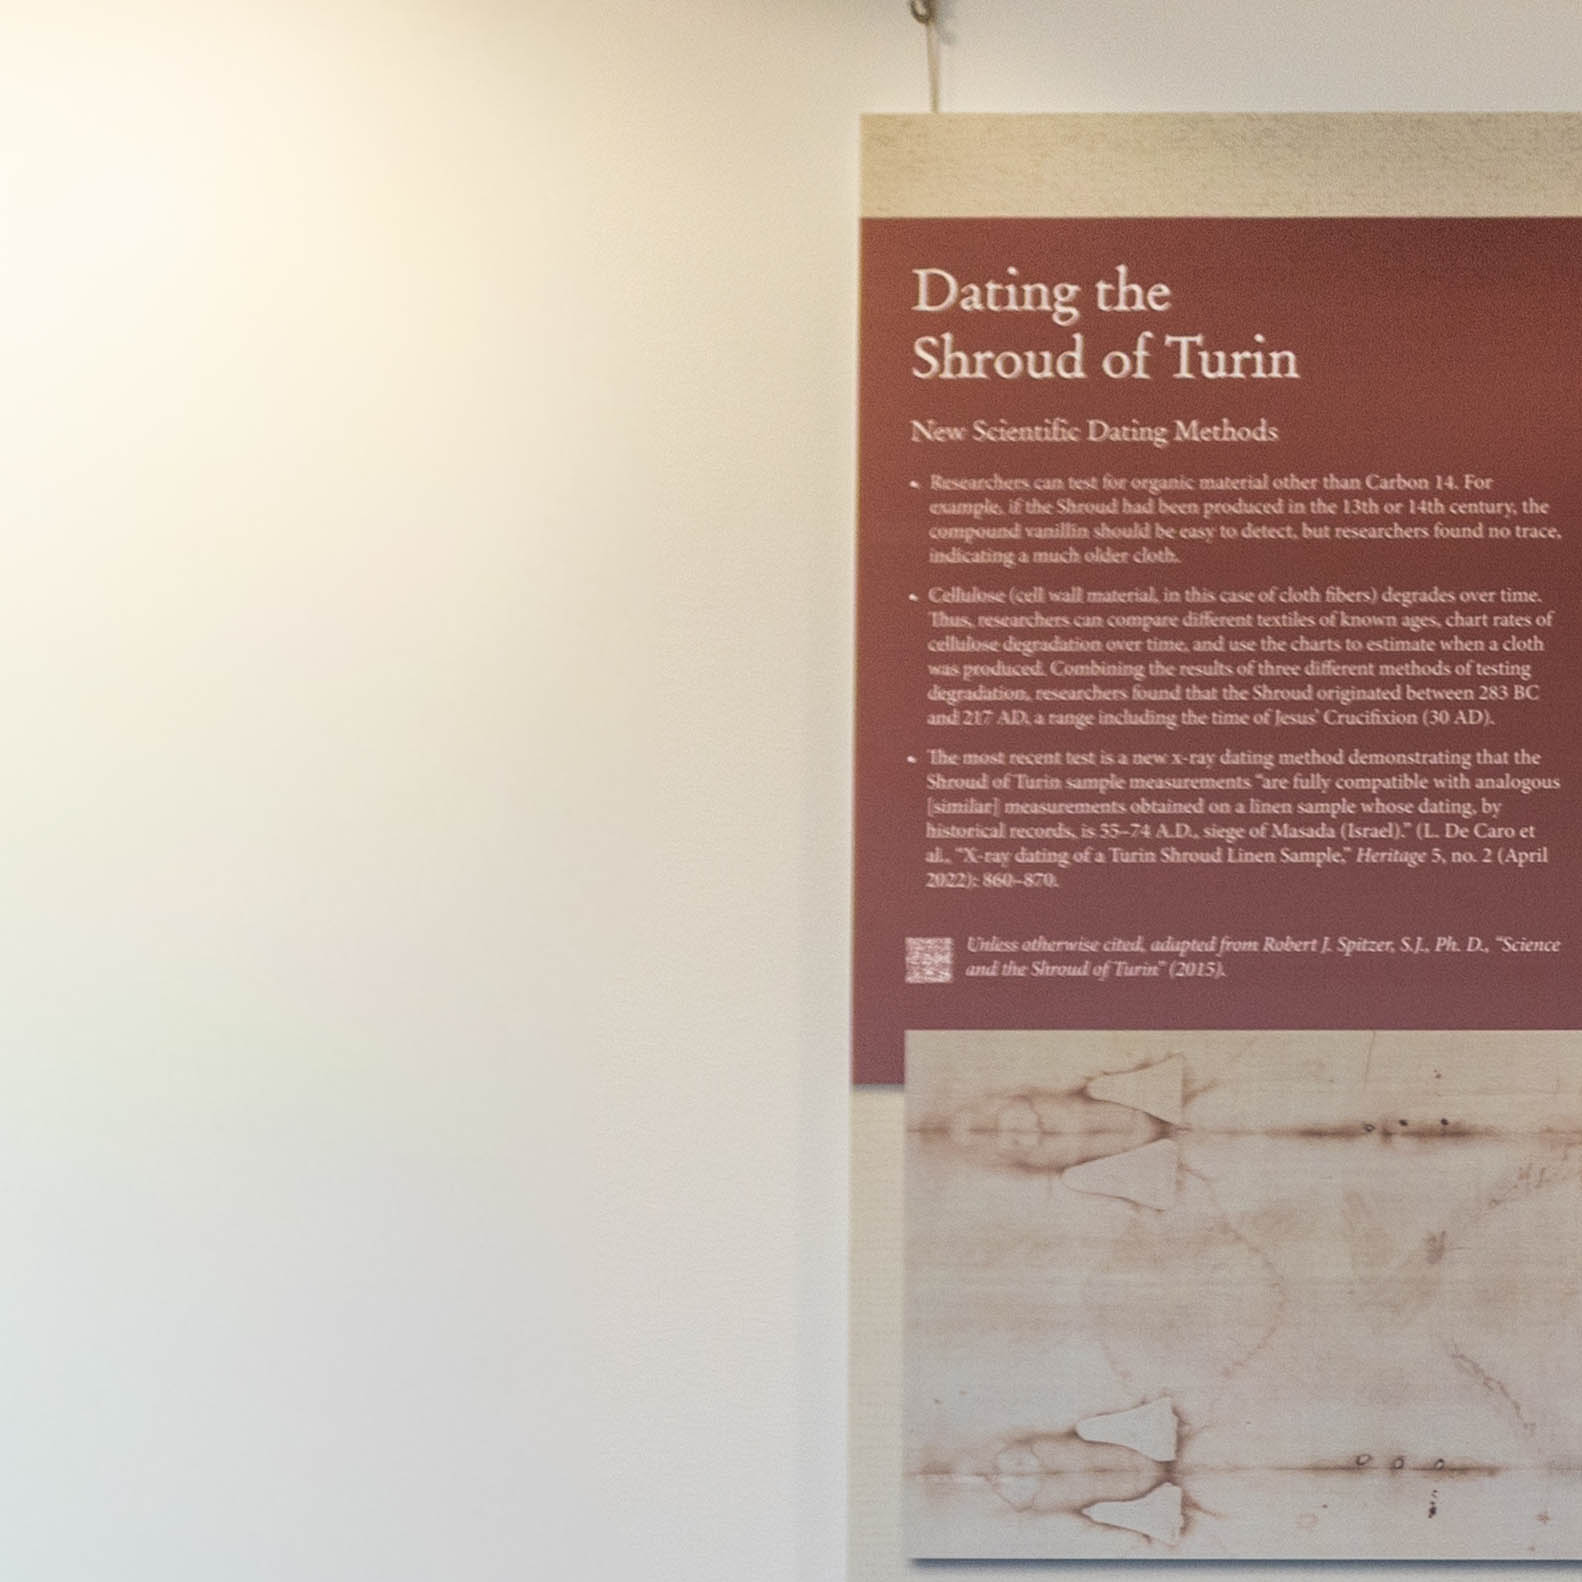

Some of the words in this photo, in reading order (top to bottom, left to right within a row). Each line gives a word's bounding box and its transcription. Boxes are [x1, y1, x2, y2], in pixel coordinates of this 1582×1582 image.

[912, 267, 1081, 326] Dating
[1096, 264, 1171, 311] the
[913, 333, 1086, 379] Shroud
[1102, 331, 1153, 378] of
[1165, 334, 1300, 378] Turin
[910, 420, 966, 442] New
[973, 418, 1081, 441] Scientific
[1087, 419, 1168, 448] Dating
[1174, 418, 1278, 441] Methods
